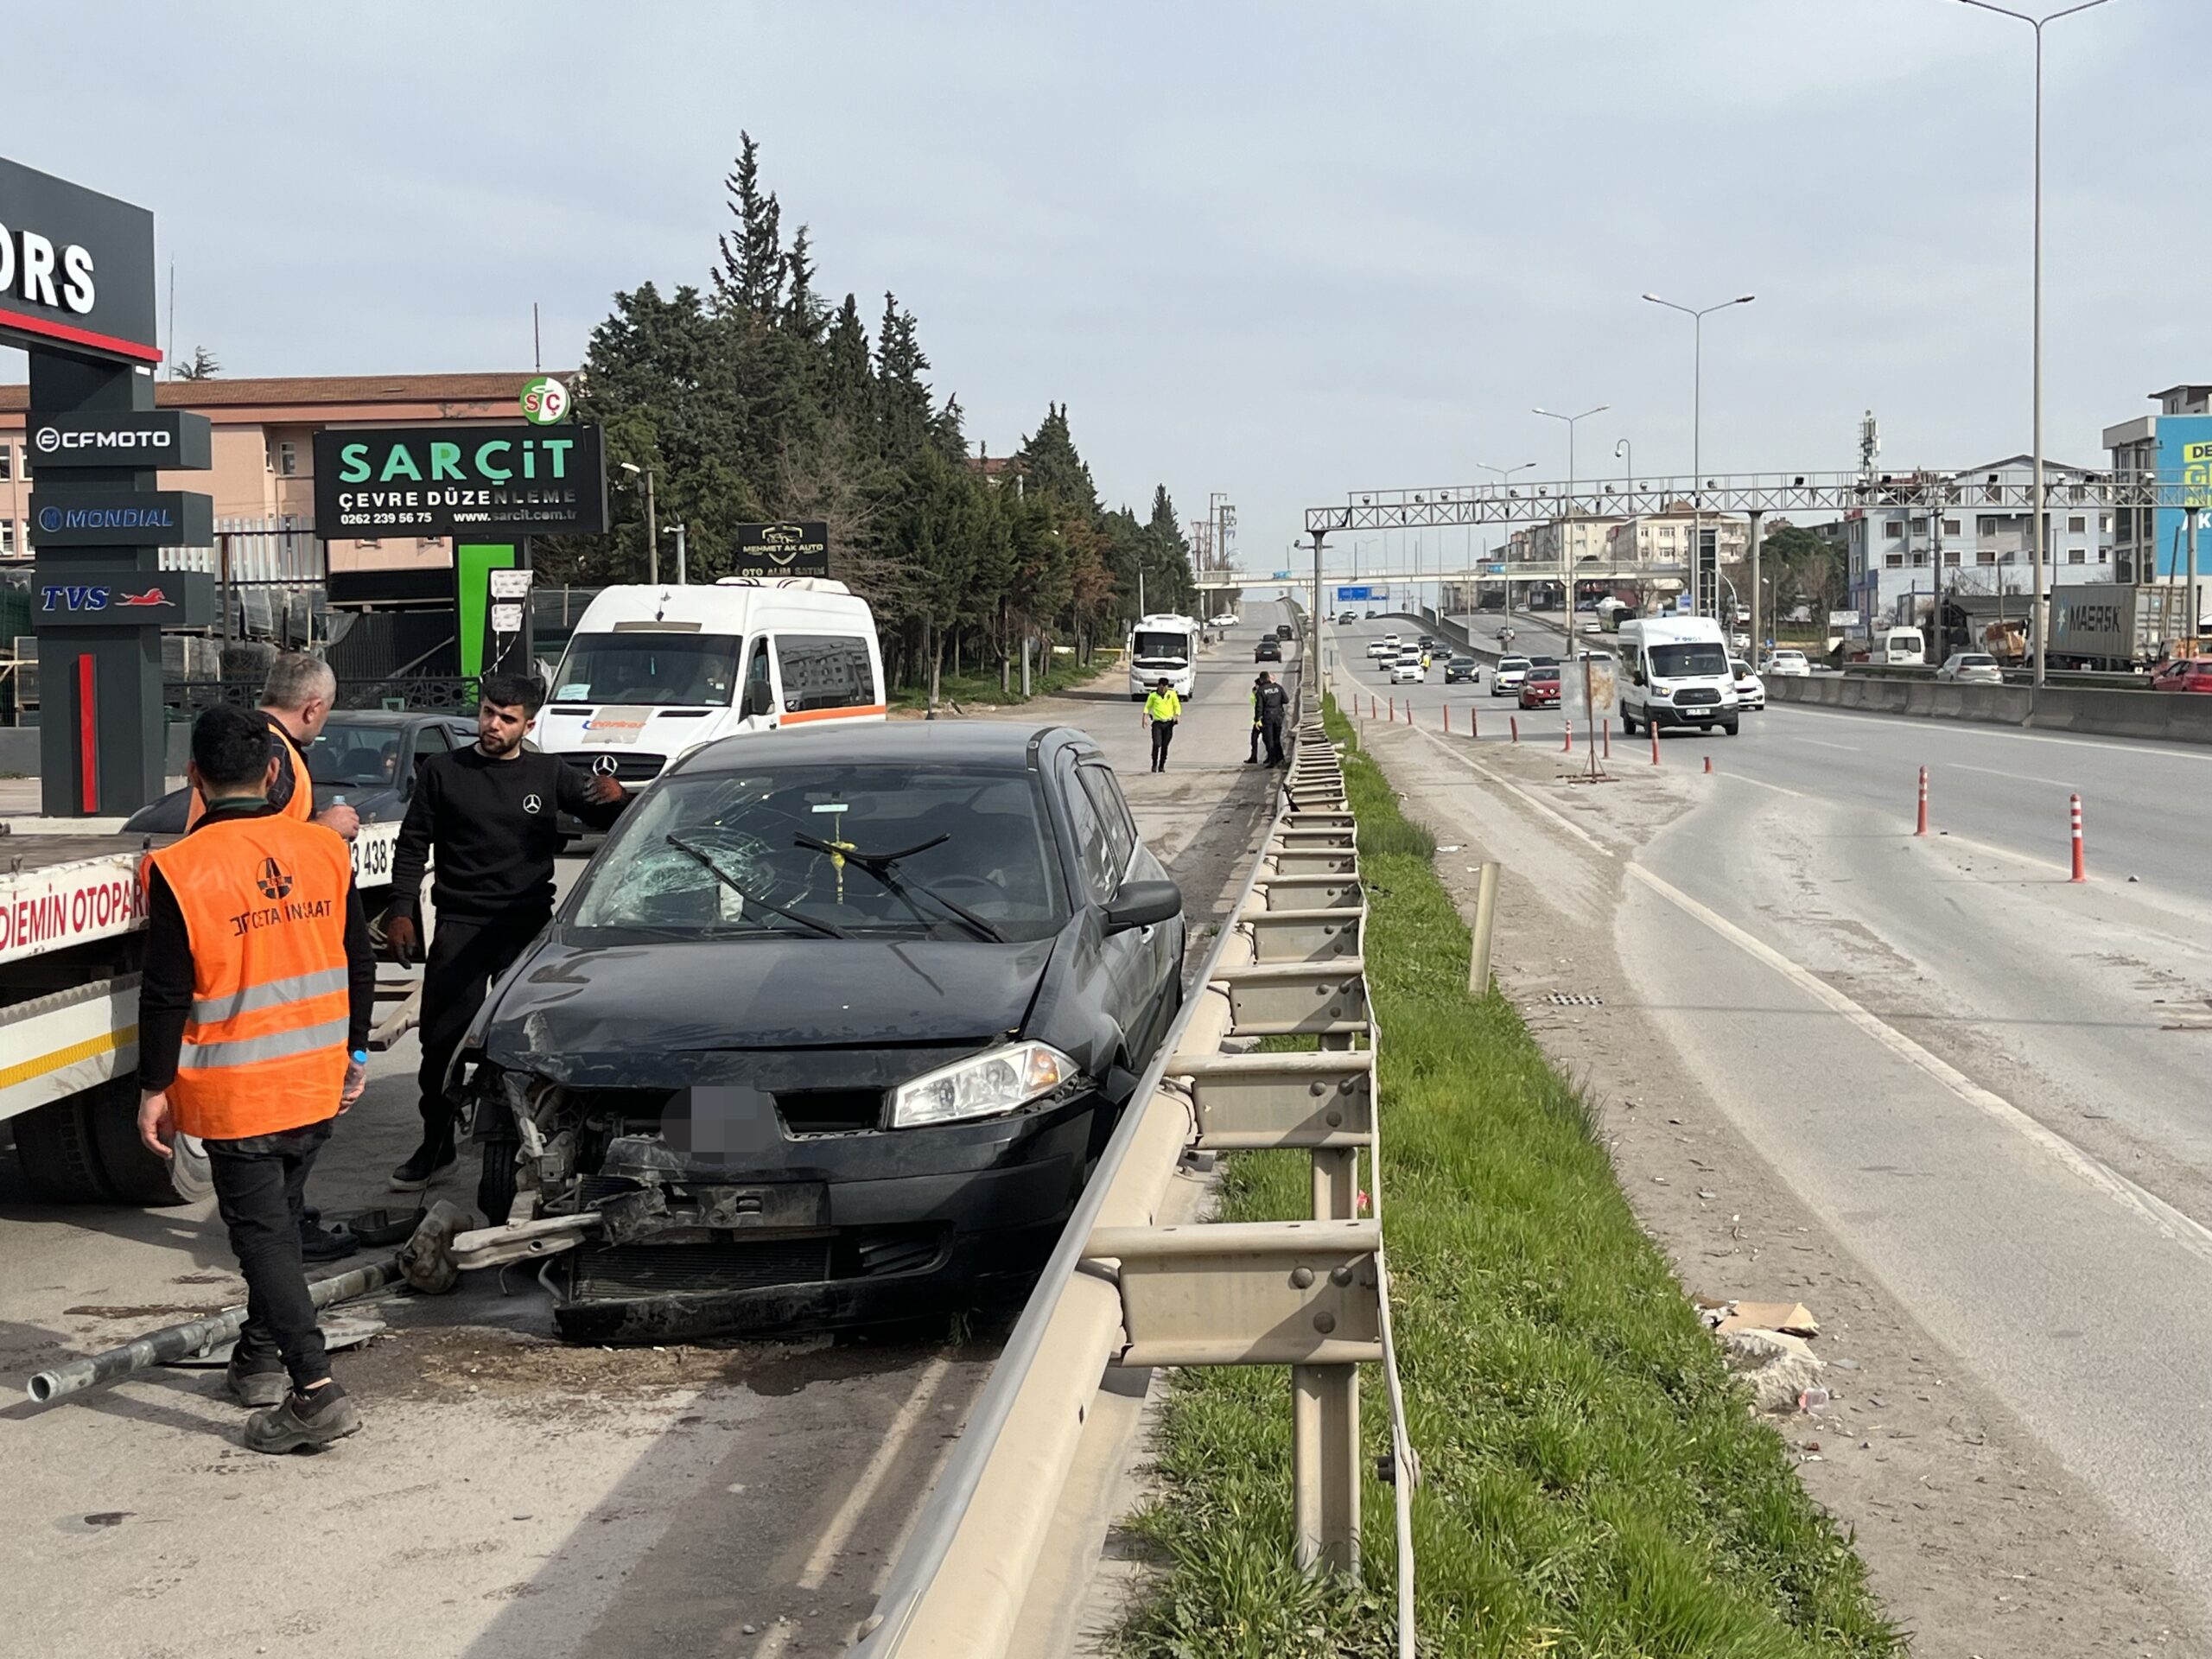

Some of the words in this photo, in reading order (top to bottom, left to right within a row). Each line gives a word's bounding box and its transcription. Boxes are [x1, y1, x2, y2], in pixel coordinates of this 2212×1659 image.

[62, 431, 171, 448] CFMOTO
[339, 492, 418, 512] ÇEVRE
[427, 486, 577, 506] DÜZENLEME
[66, 509, 174, 528] MONDIAL
[340, 513, 371, 524] 0262
[373, 513, 396, 524] 239
[398, 512, 414, 524] 56
[416, 512, 433, 523] 75
[741, 568, 763, 577] OTO
[41, 586, 111, 611] TVS
[2069, 606, 2120, 632] MAERSK
[364, 839, 388, 875] 438
